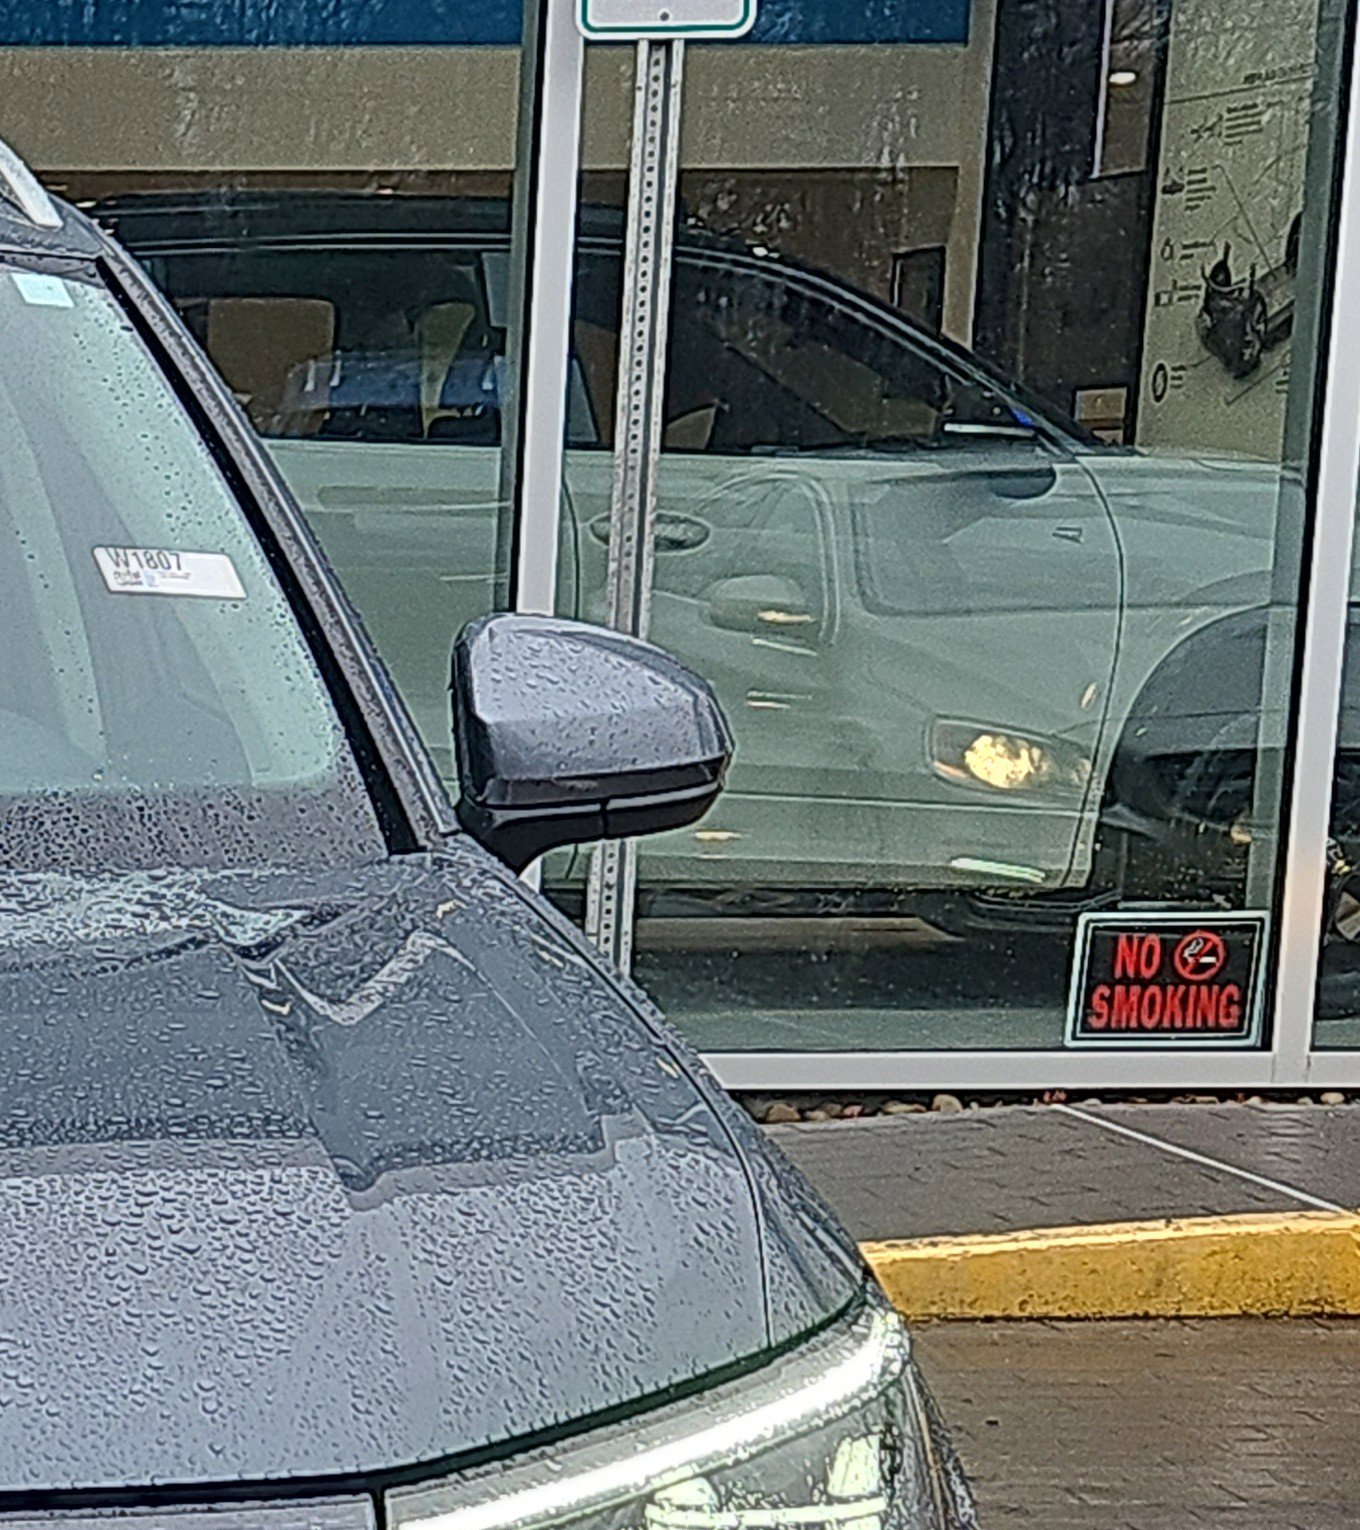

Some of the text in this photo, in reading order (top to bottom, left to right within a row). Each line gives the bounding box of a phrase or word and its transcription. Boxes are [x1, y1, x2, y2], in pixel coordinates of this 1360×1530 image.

[104, 547, 182, 571] W1807
[1114, 932, 1161, 979] NO
[1088, 983, 1241, 1029] SMOKING
